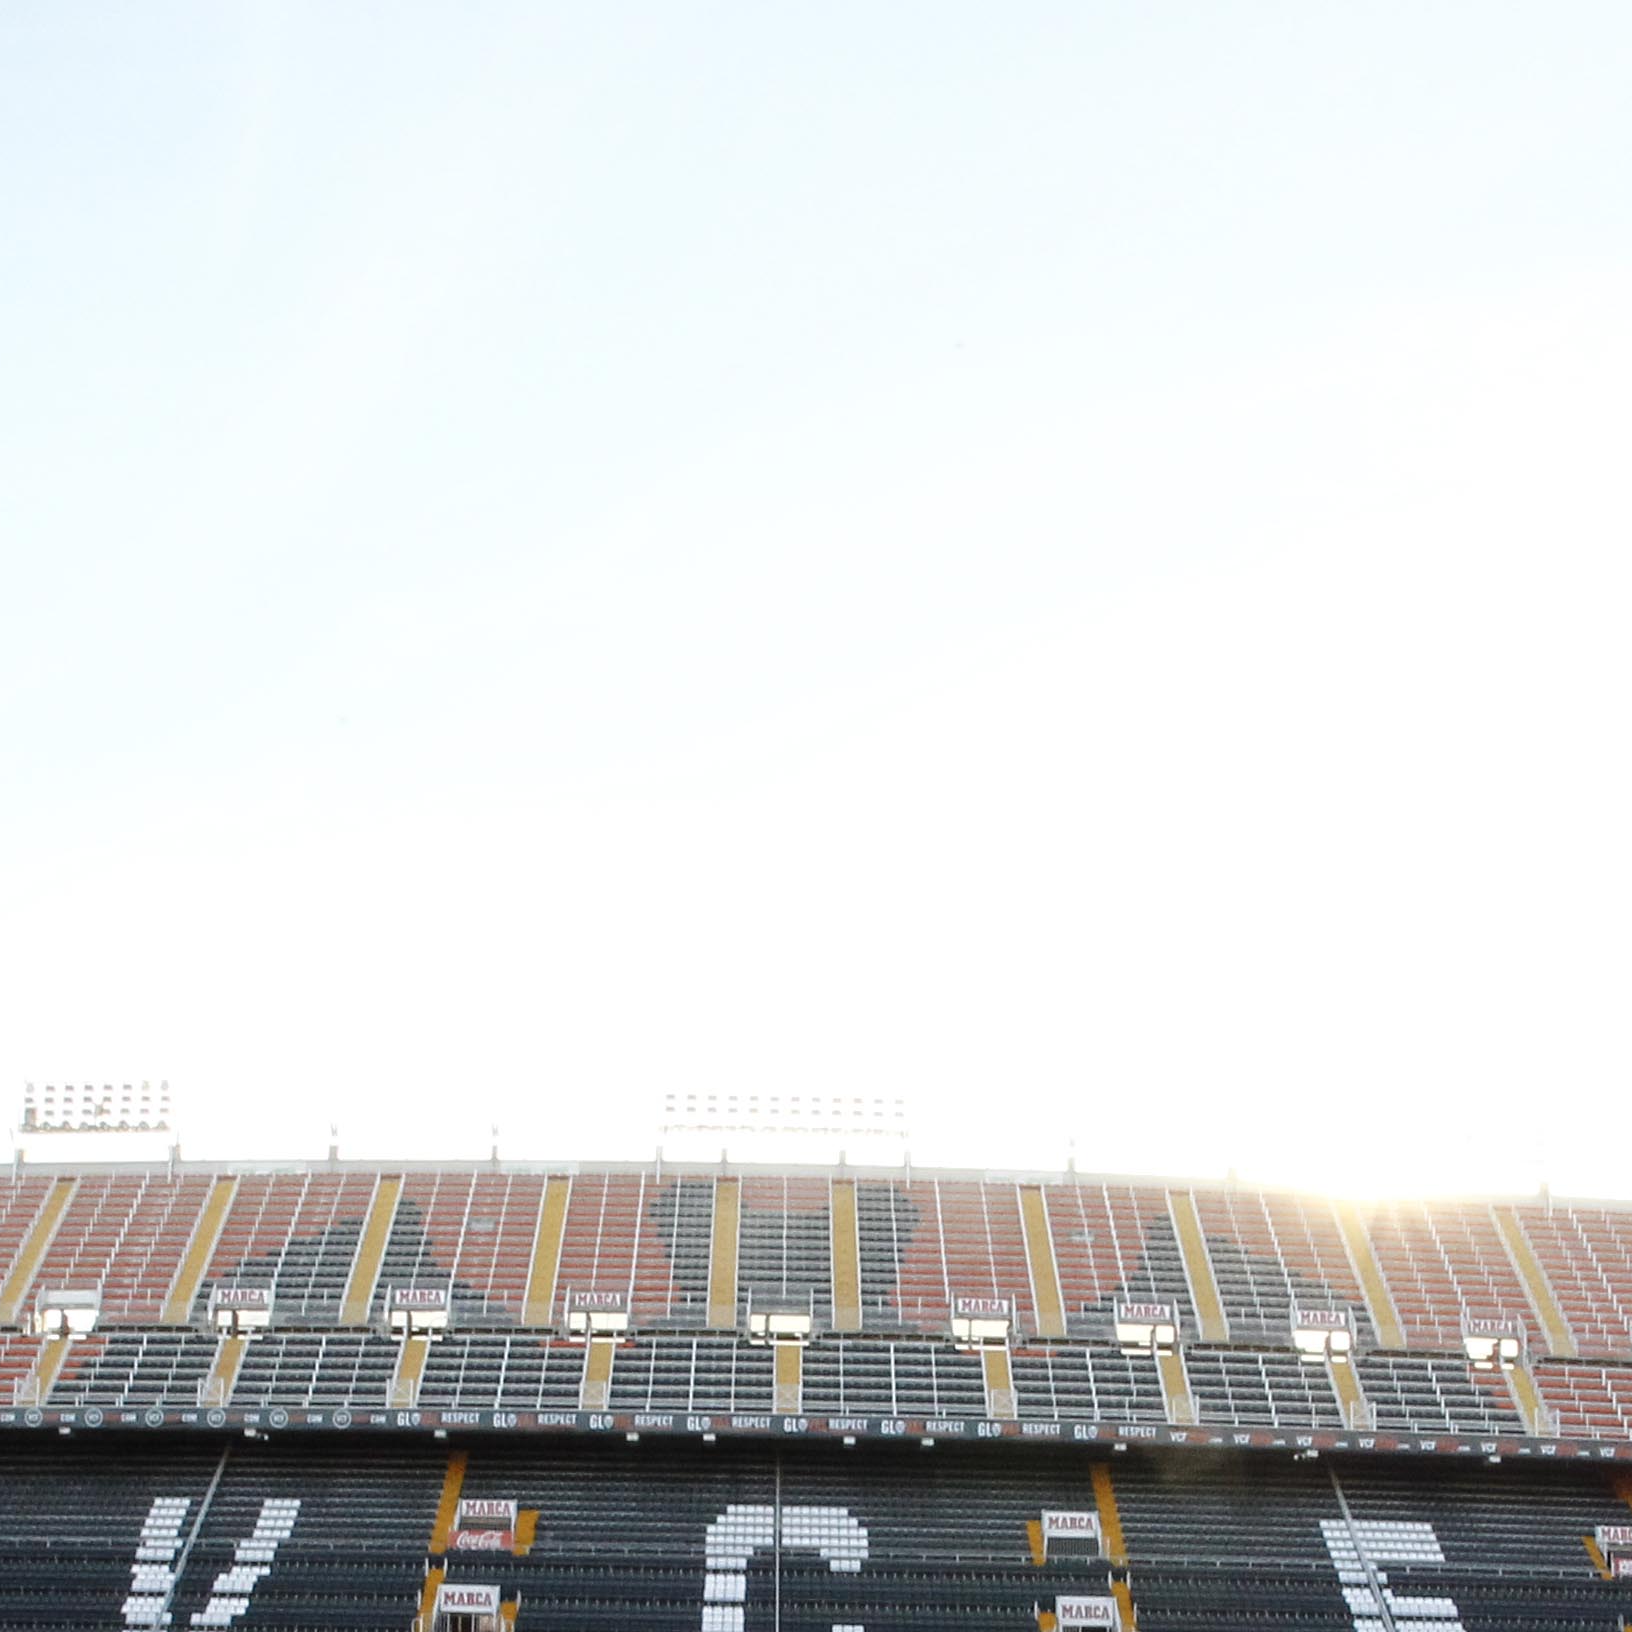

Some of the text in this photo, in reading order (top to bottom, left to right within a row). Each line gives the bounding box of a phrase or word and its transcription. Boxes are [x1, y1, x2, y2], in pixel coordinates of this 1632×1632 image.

[221, 1290, 265, 1302] MARCA
[398, 1291, 441, 1304] MARCA
[575, 1293, 620, 1306] MARCA
[961, 1299, 1005, 1312] MARCA
[1123, 1304, 1166, 1317] MARCA
[441, 1412, 479, 1424] RESPECT
[634, 1414, 673, 1427] RESPECT
[828, 1419, 867, 1430] RESPECT
[1022, 1423, 1061, 1434] RESPECT
[1118, 1426, 1156, 1438] RESPECT
[465, 1502, 510, 1515] MARCA
[1048, 1516, 1093, 1530] MARCA
[444, 1593, 491, 1606] MARCA
[1061, 1605, 1109, 1619] MARCA
